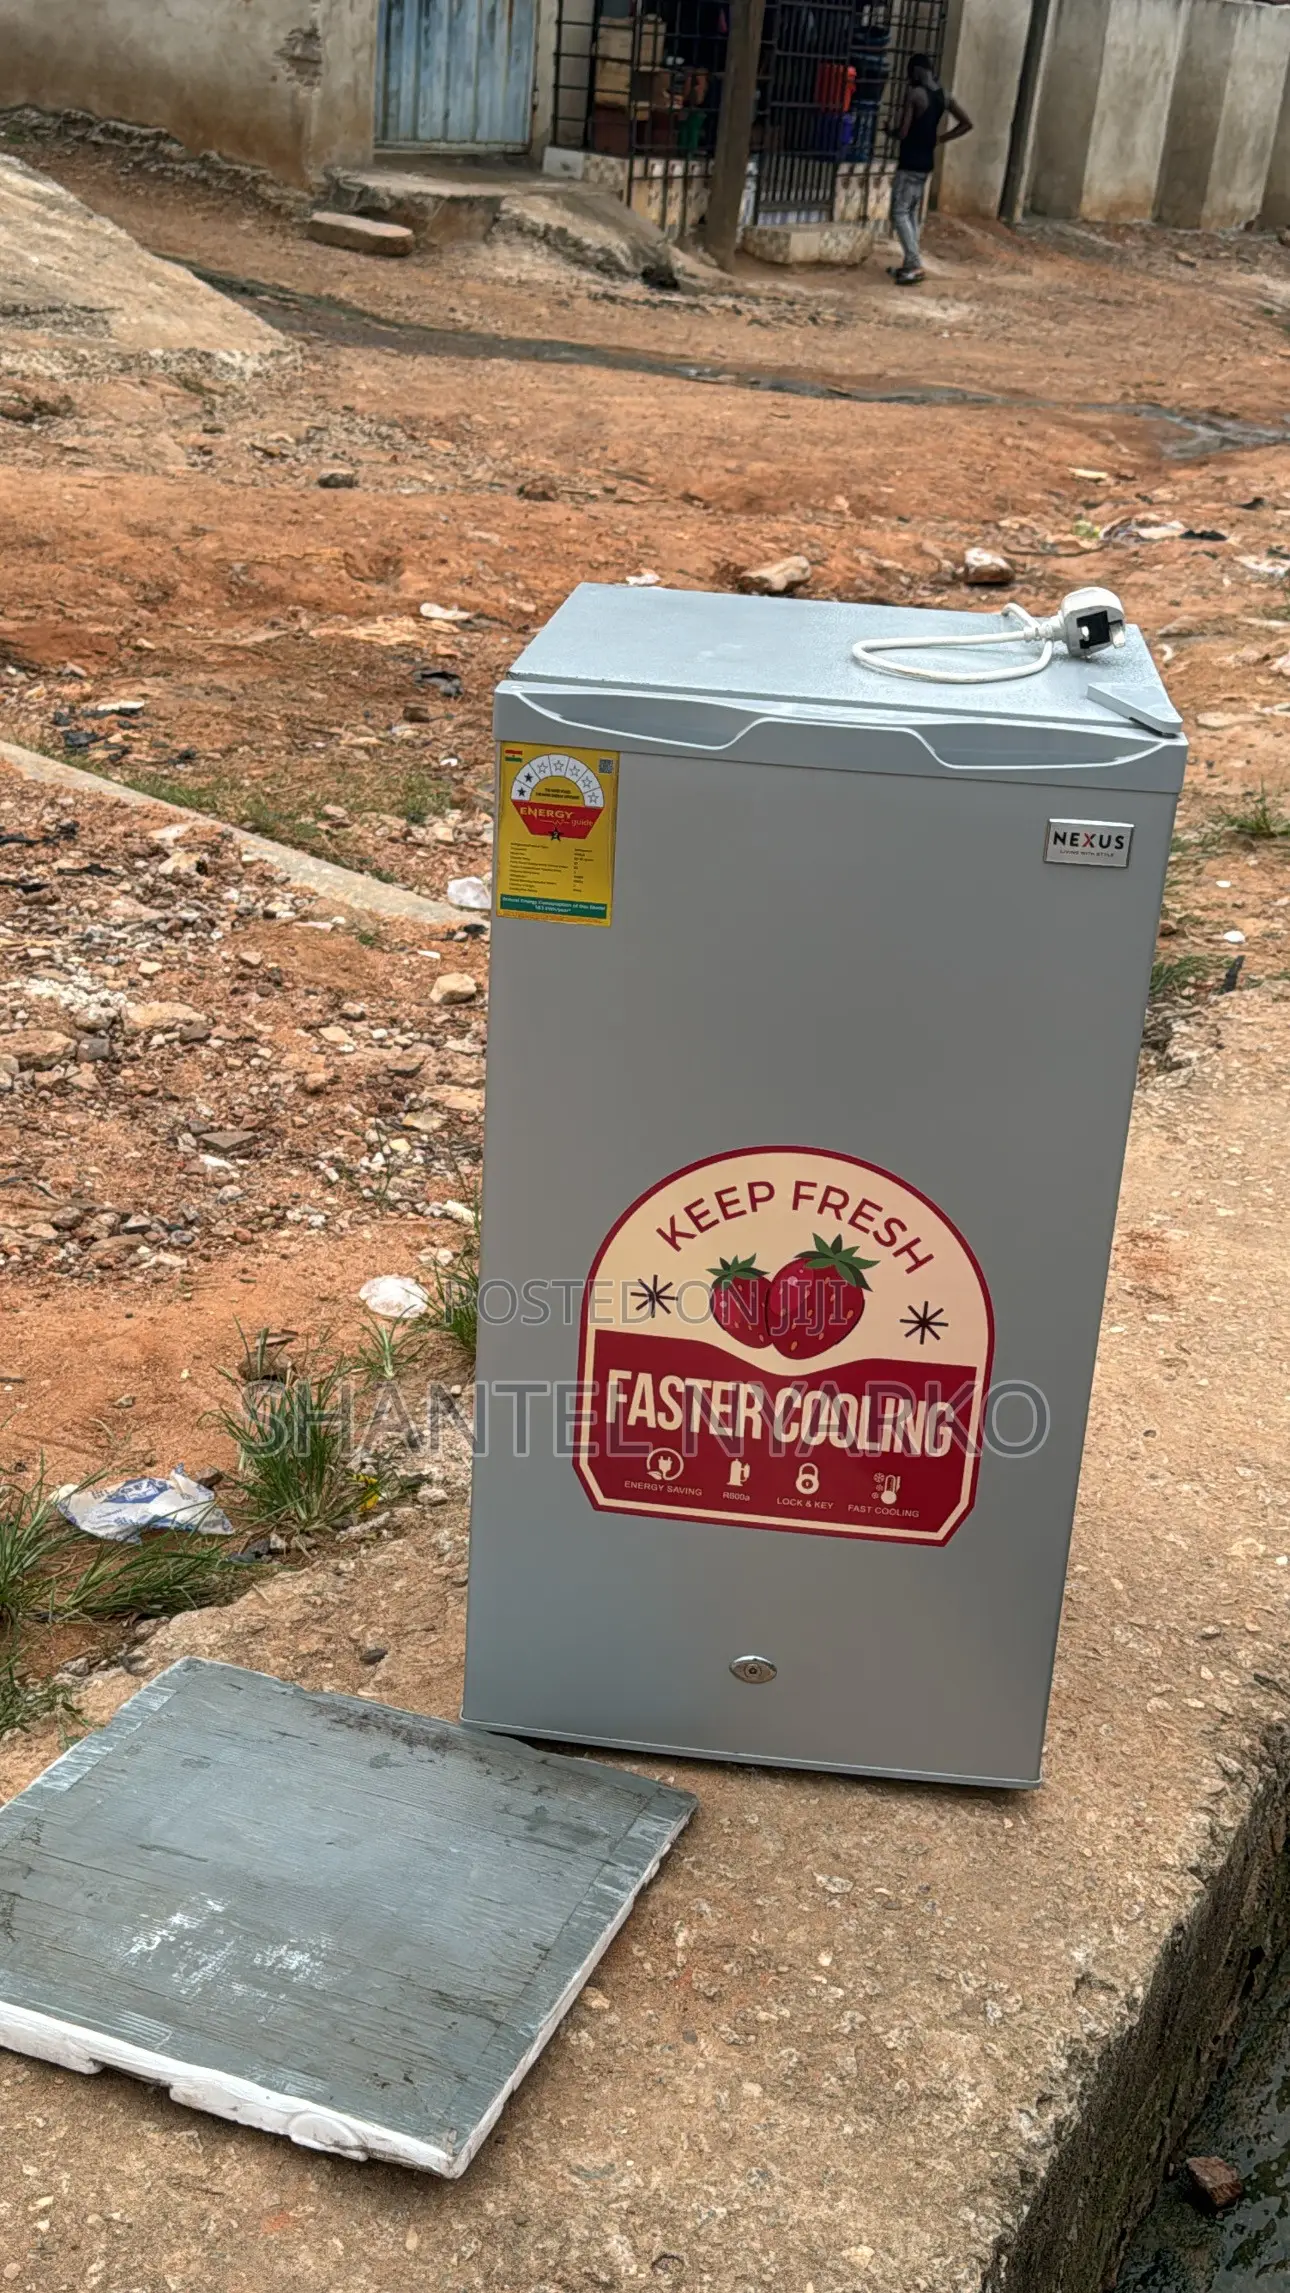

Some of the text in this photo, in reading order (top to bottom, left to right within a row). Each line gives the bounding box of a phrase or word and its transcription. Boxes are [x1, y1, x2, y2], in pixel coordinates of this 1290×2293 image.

[520, 806, 574, 819] ENERGY
[572, 819, 593, 828] guide
[1053, 831, 1125, 850] NEXUS
[656, 1180, 935, 1275] KEEP FRESH
[606, 1369, 954, 1457] FASTER COOLING
[624, 1480, 702, 1496] ENERGY SAVING
[777, 1497, 834, 1510] LOCK & KEY
[848, 1504, 920, 1518] FAST COOLING
